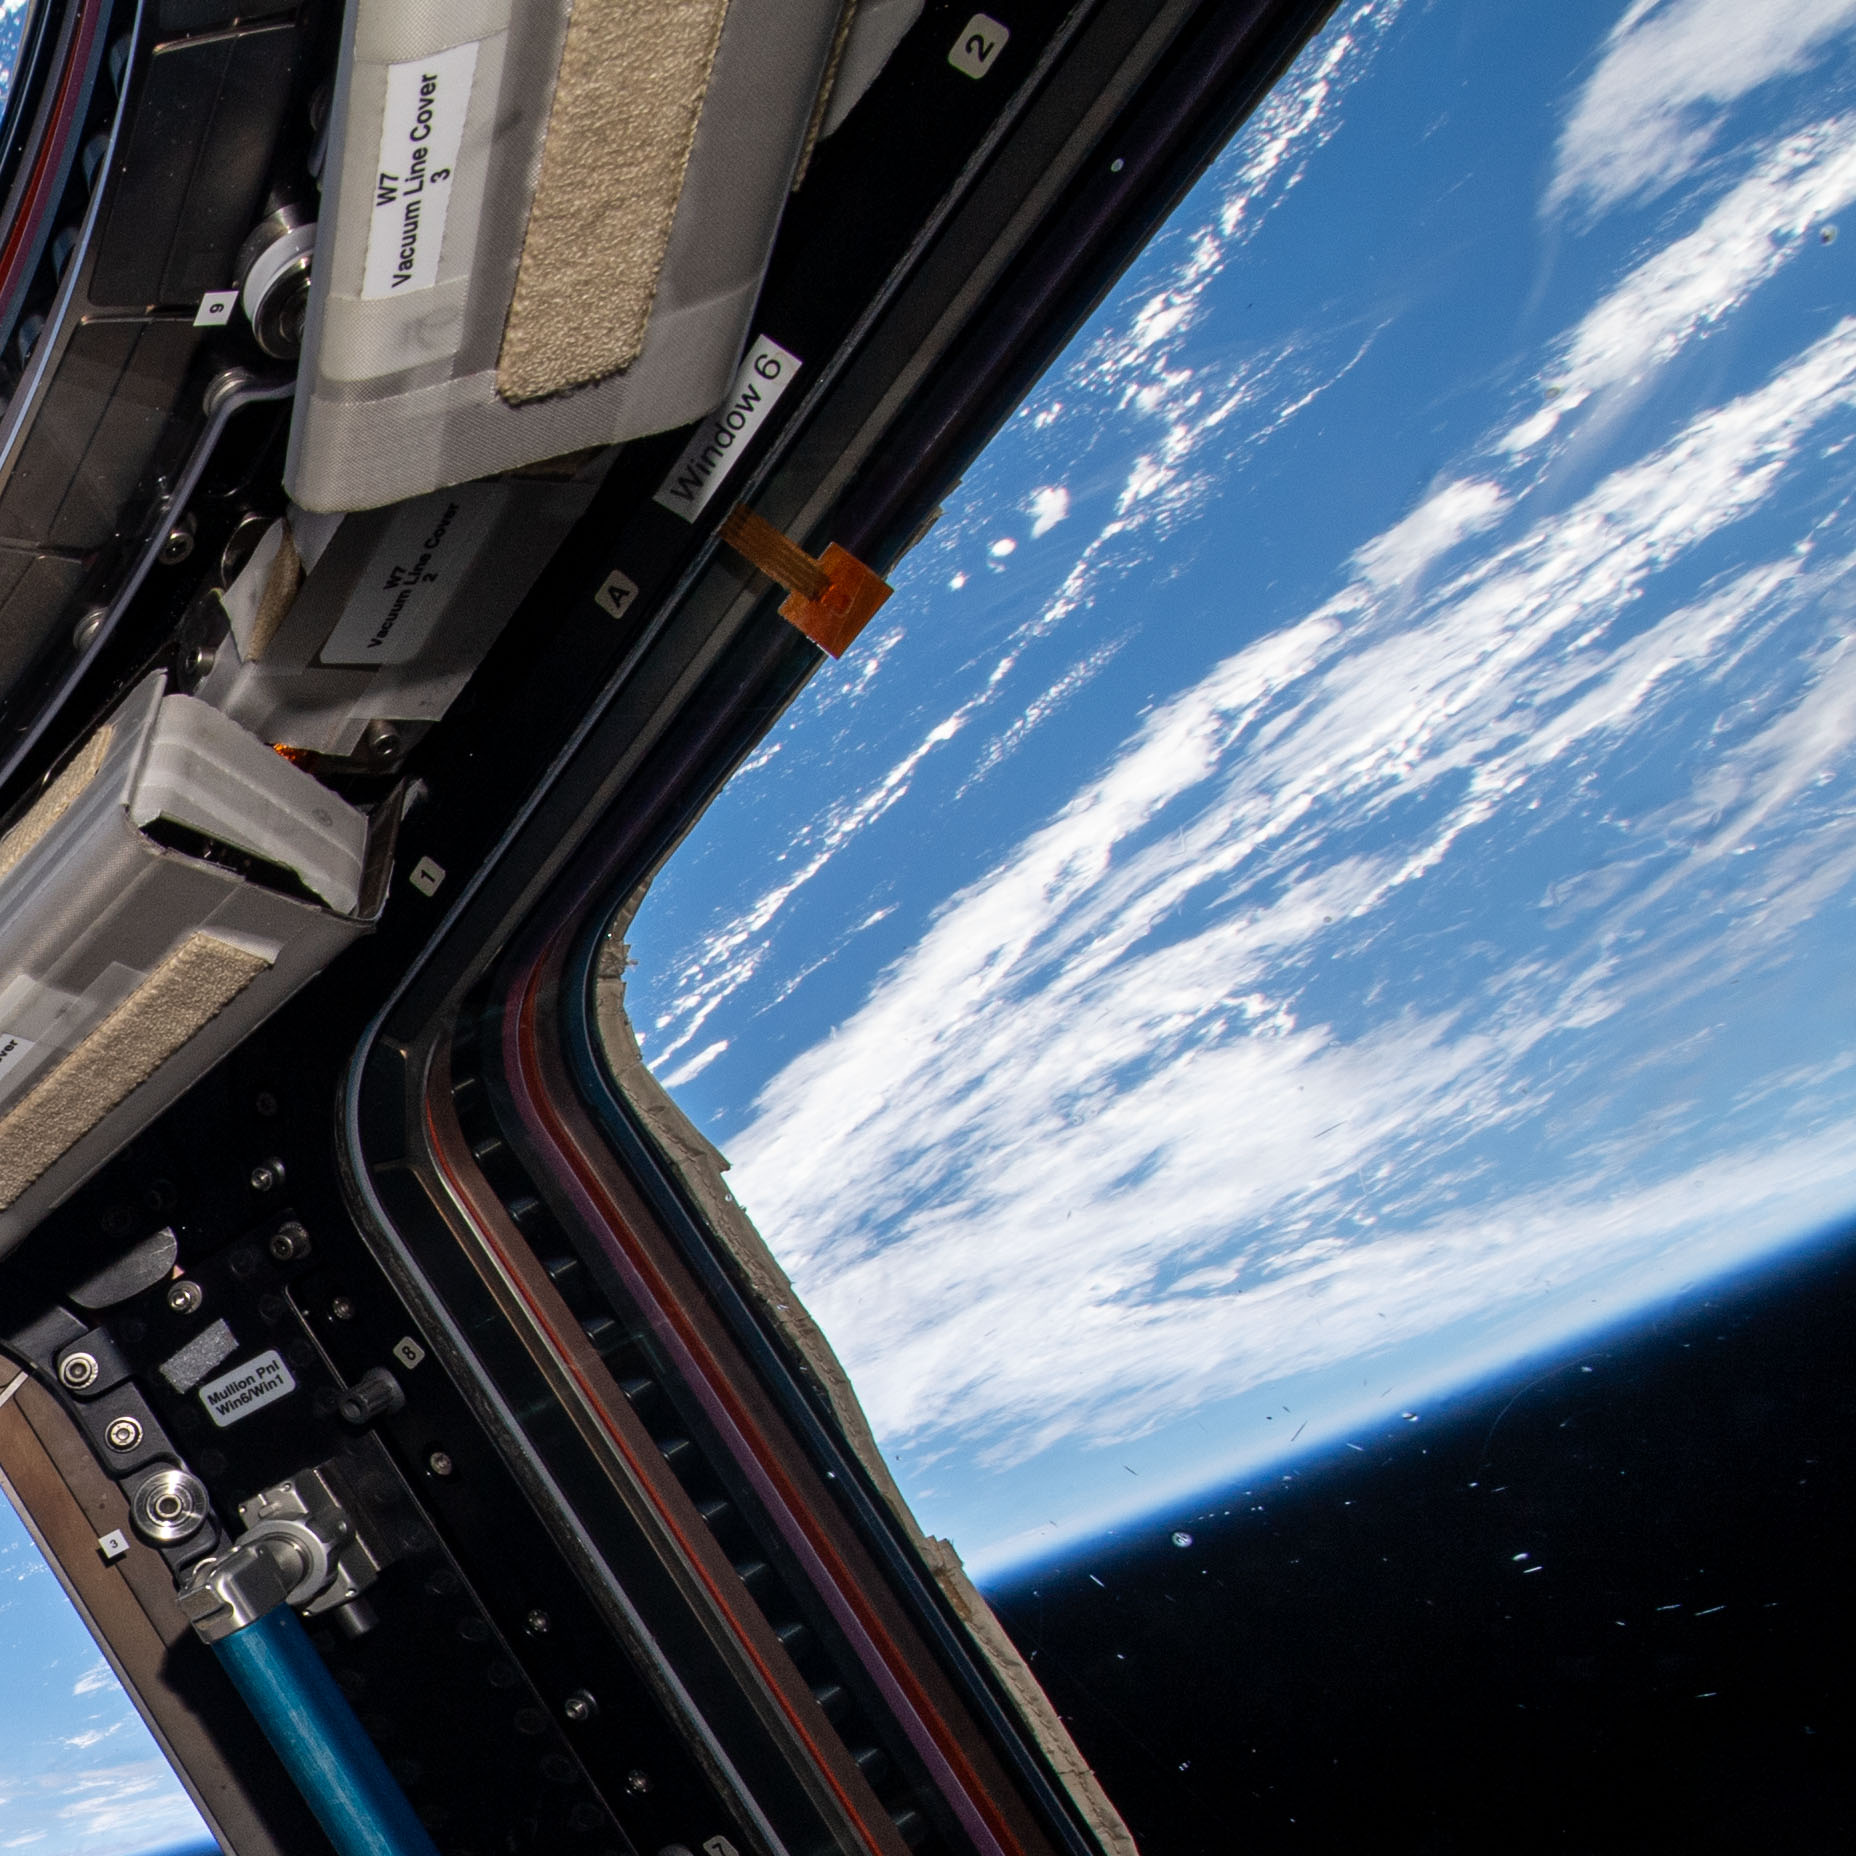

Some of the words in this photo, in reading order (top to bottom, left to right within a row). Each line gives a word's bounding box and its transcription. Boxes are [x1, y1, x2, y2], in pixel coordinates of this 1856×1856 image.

[965, 34, 994, 62] 2
[410, 74, 438, 142] Cover
[404, 147, 428, 196] Line
[430, 168, 450, 184] 3
[377, 173, 400, 206] W7
[392, 200, 422, 288] Vacuum
[670, 384, 762, 502] Window
[754, 354, 782, 380] 6
[367, 590, 412, 648] Vacuum
[404, 554, 432, 586] Line
[425, 503, 460, 550] Cover
[384, 566, 406, 590] W7
[422, 573, 438, 582] 2
[608, 586, 630, 608] A
[421, 870, 436, 884] 1
[402, 1346, 416, 1362] 8
[207, 1374, 256, 1406] Mullion
[256, 1360, 280, 1378] Pnl
[215, 1374, 284, 1416] Win6/Win1
